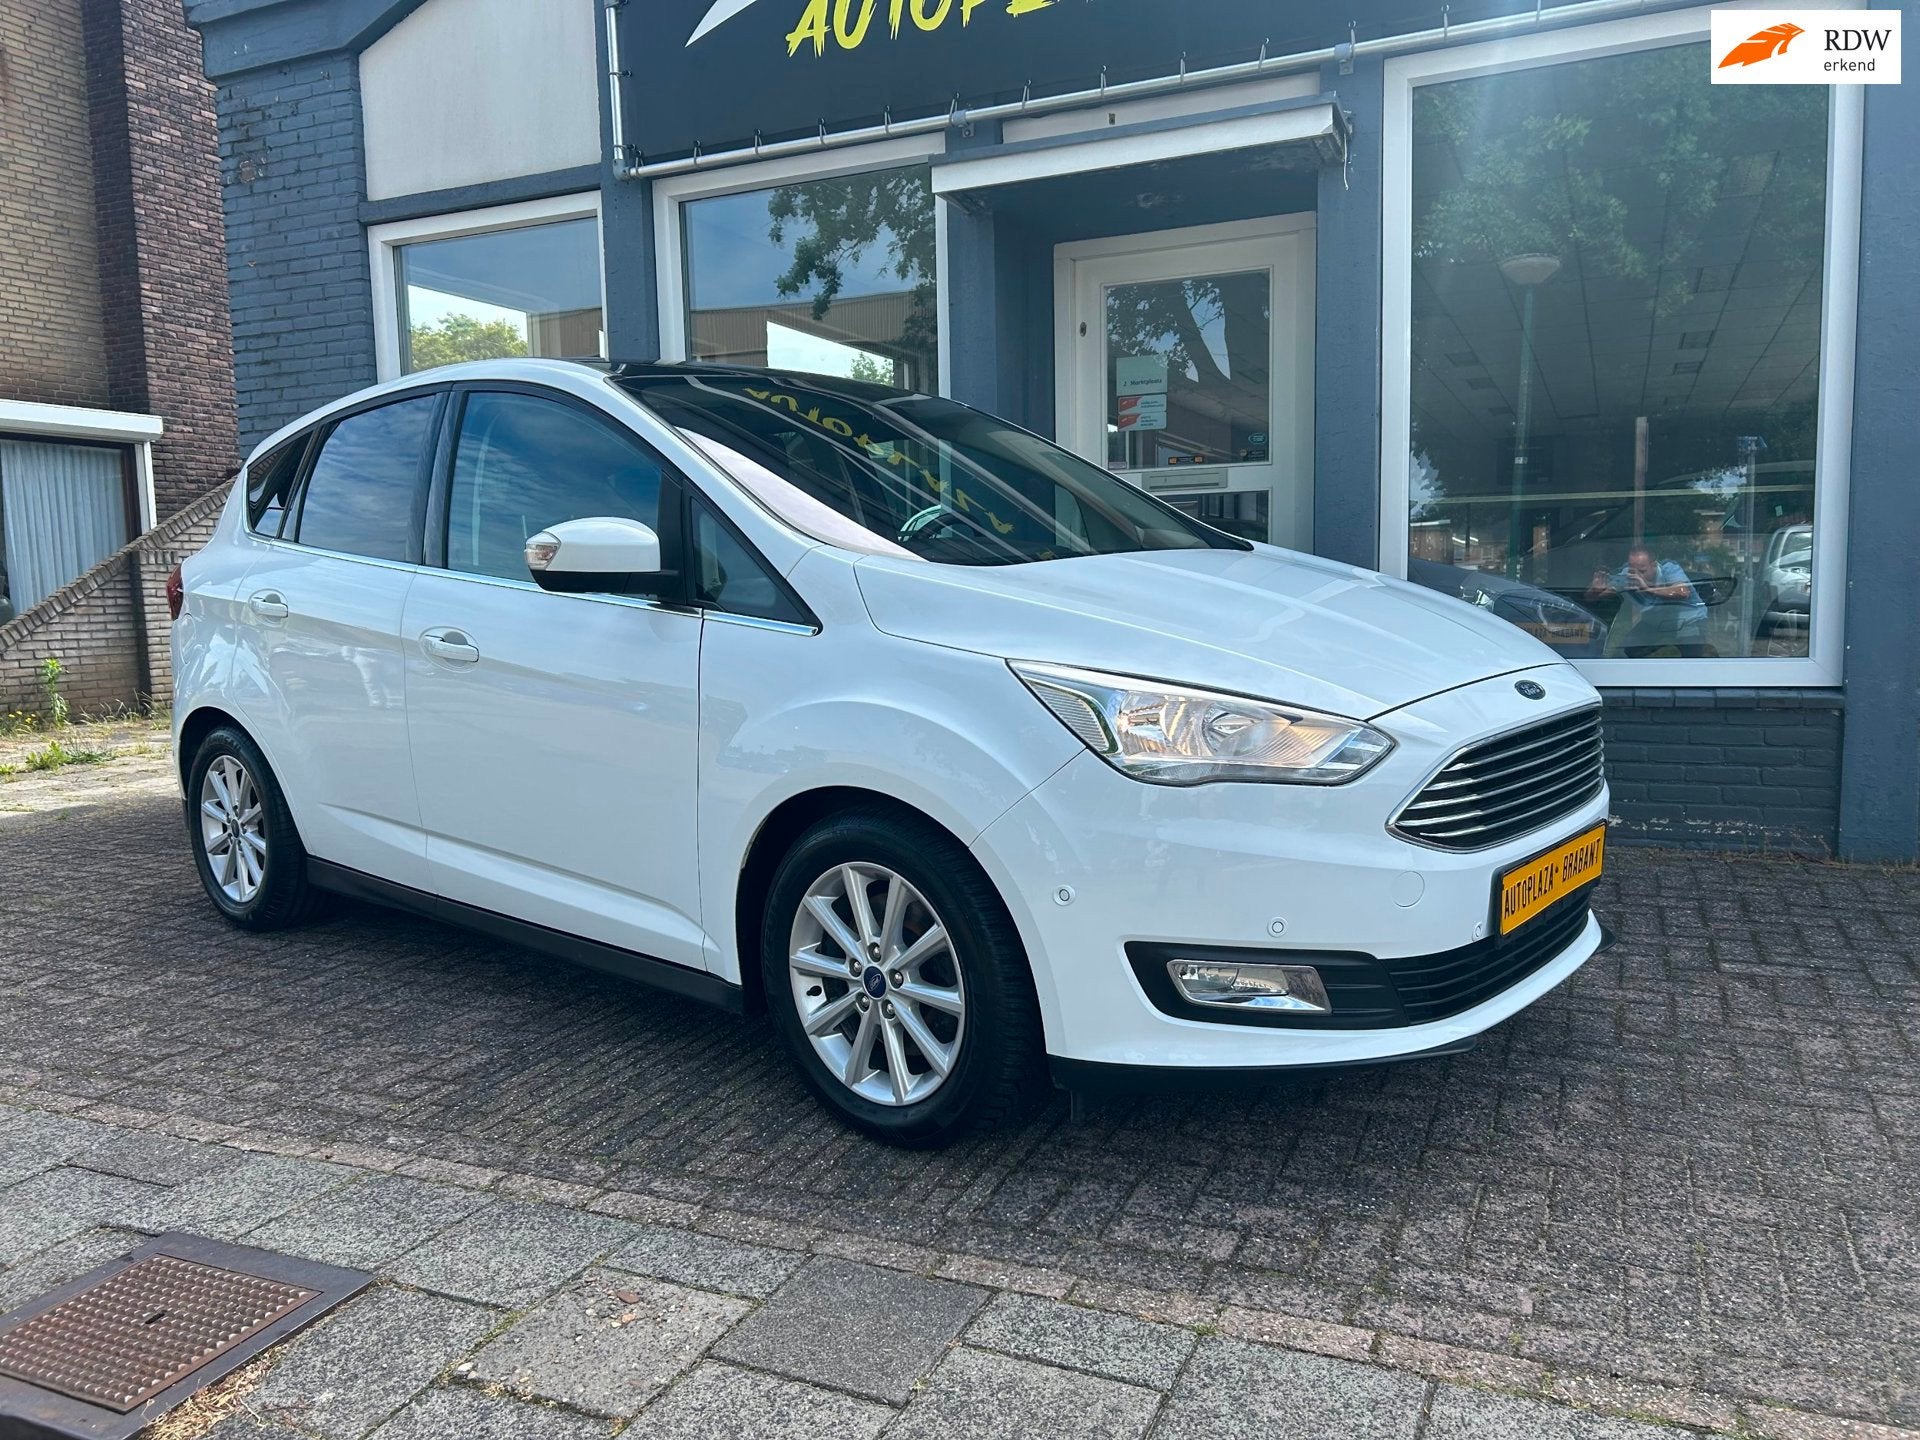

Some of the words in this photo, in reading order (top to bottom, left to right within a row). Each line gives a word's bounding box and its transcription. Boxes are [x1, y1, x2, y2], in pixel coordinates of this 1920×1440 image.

[785, 0, 1058, 58] AUTO
[1505, 863, 1554, 920] AUTOPLAZA
[1562, 838, 1600, 883] BRABANT
